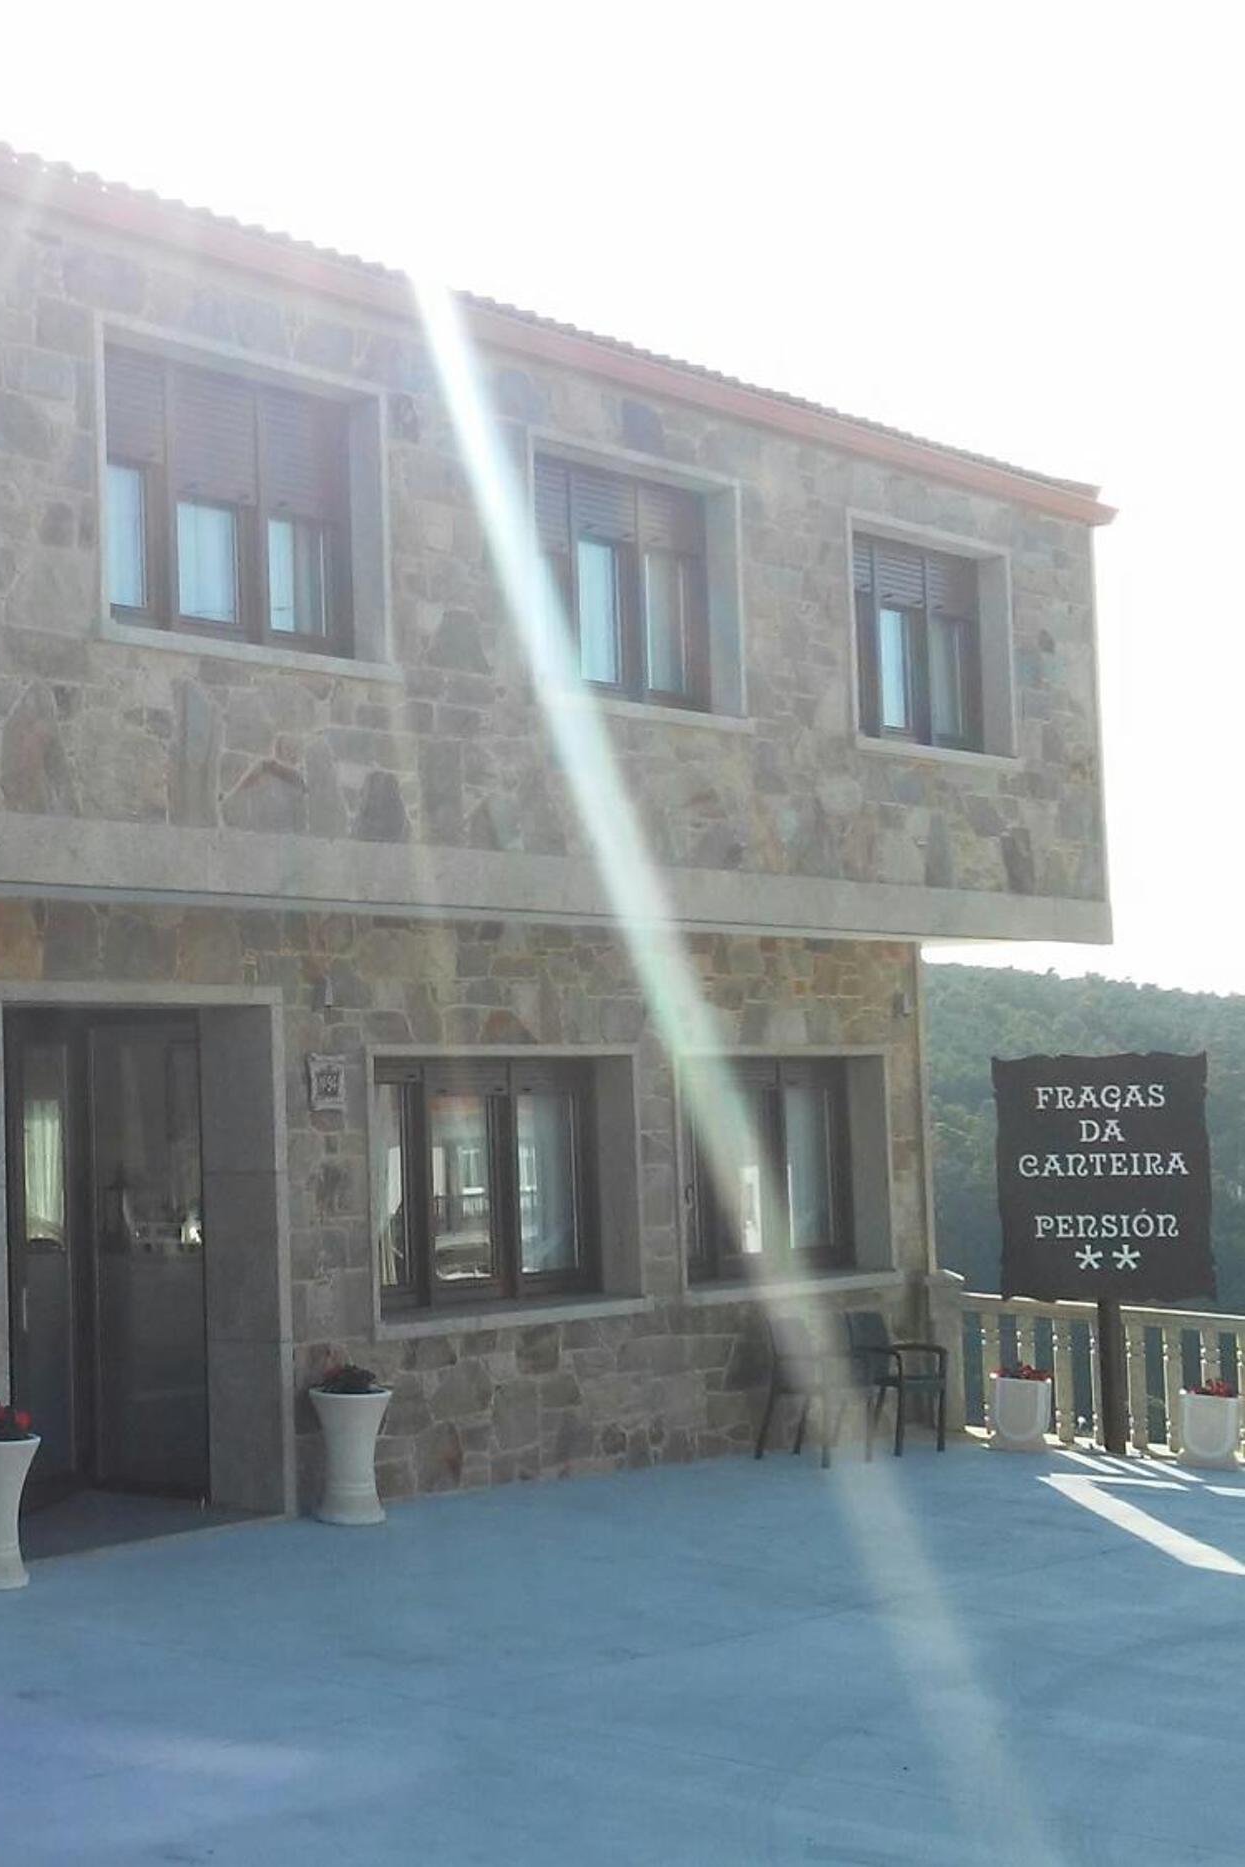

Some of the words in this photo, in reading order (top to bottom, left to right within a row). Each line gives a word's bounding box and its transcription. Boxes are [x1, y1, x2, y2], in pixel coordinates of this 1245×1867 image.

[1035, 1084, 1166, 1112] FRAGAS
[1078, 1119, 1125, 1142] DA
[1018, 1153, 1189, 1177] CANTEIRA
[1034, 1207, 1179, 1238] PENSIÓN
